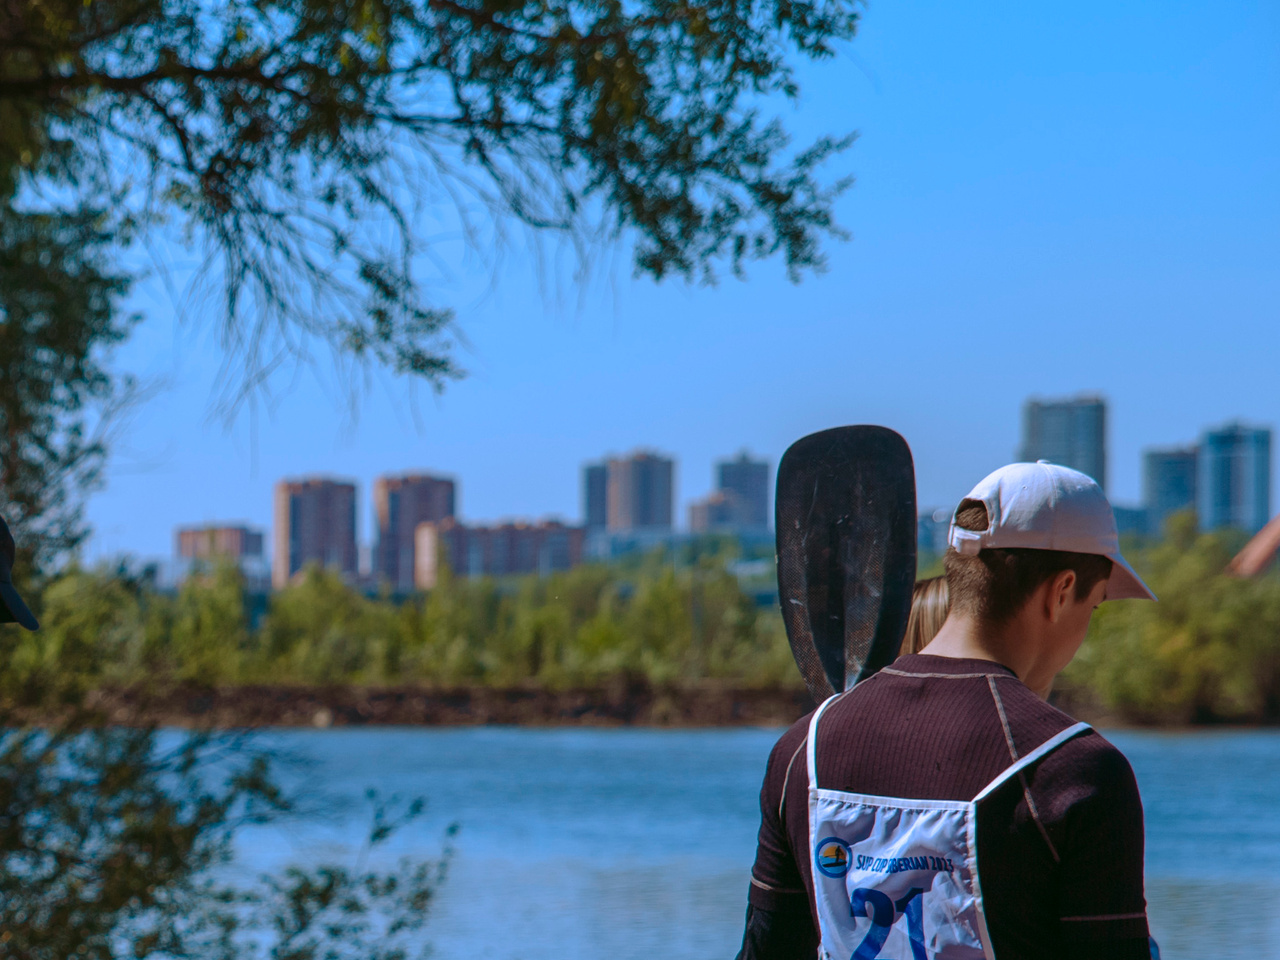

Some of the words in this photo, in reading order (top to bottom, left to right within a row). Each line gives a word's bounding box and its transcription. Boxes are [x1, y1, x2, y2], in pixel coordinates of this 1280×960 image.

[856, 854, 874, 871] SUP
[871, 856, 888, 873] CUP
[885, 855, 930, 874] SIBERIAN
[928, 855, 955, 873] 2023
